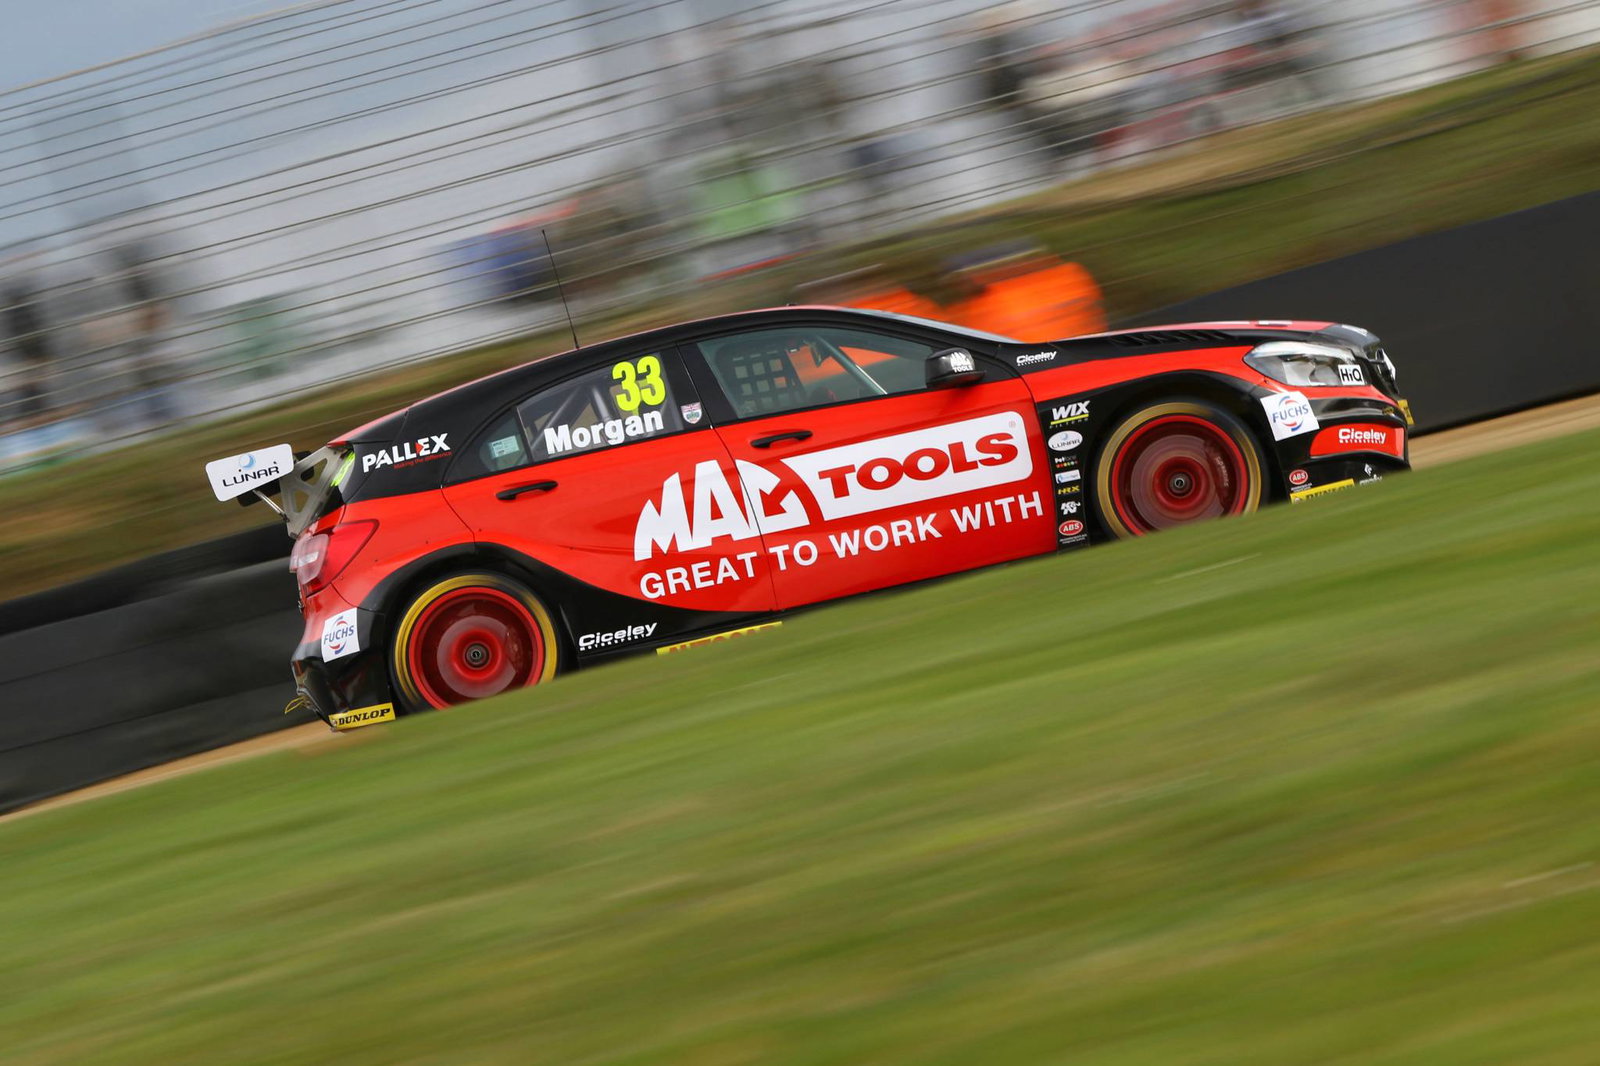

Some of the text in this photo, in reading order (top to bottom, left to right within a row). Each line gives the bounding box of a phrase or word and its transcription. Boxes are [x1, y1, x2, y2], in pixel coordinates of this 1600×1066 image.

[1016, 351, 1057, 364] Ciceley
[612, 355, 666, 412] 33
[1340, 368, 1362, 383] HiQ
[1052, 400, 1090, 421] WIX
[1272, 405, 1309, 424] FUCHS
[543, 410, 664, 455] Morgan
[1338, 428, 1386, 444] Ciceley
[362, 433, 451, 473] PALLEX
[222, 464, 280, 487] LUNAR
[818, 432, 1018, 499] TOOLS
[1292, 472, 1306, 481] ABS
[634, 459, 810, 562] MAC
[1063, 523, 1080, 532] ABS
[639, 490, 1044, 600] GREAT TO WORK WITH
[323, 624, 355, 644] FUCHS
[578, 622, 658, 647] Ciceley
[338, 707, 391, 726] DUNLOP
